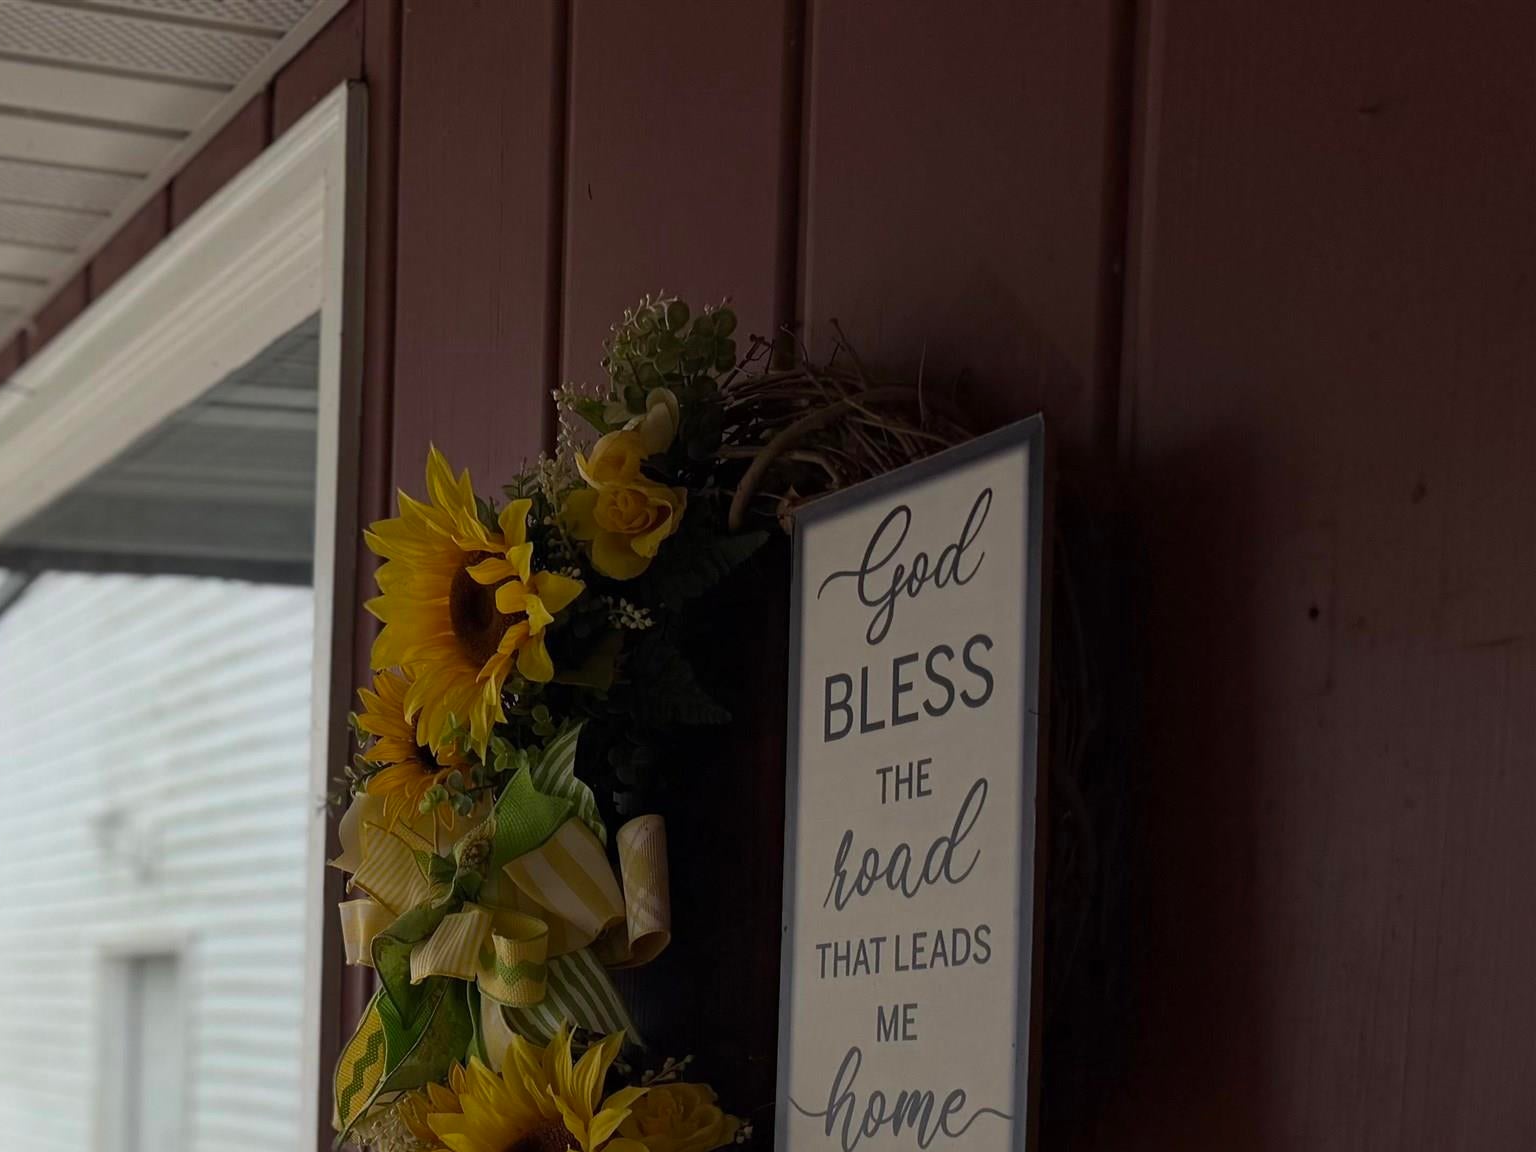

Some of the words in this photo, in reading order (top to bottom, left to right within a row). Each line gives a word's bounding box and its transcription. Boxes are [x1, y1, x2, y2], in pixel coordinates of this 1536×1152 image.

[817, 487, 993, 645] God
[824, 633, 994, 743] BLESS
[875, 757, 932, 804] THE
[823, 777, 988, 911] road
[815, 936, 887, 979] THAT
[894, 924, 992, 972] LEADS
[876, 1003, 918, 1042] ME
